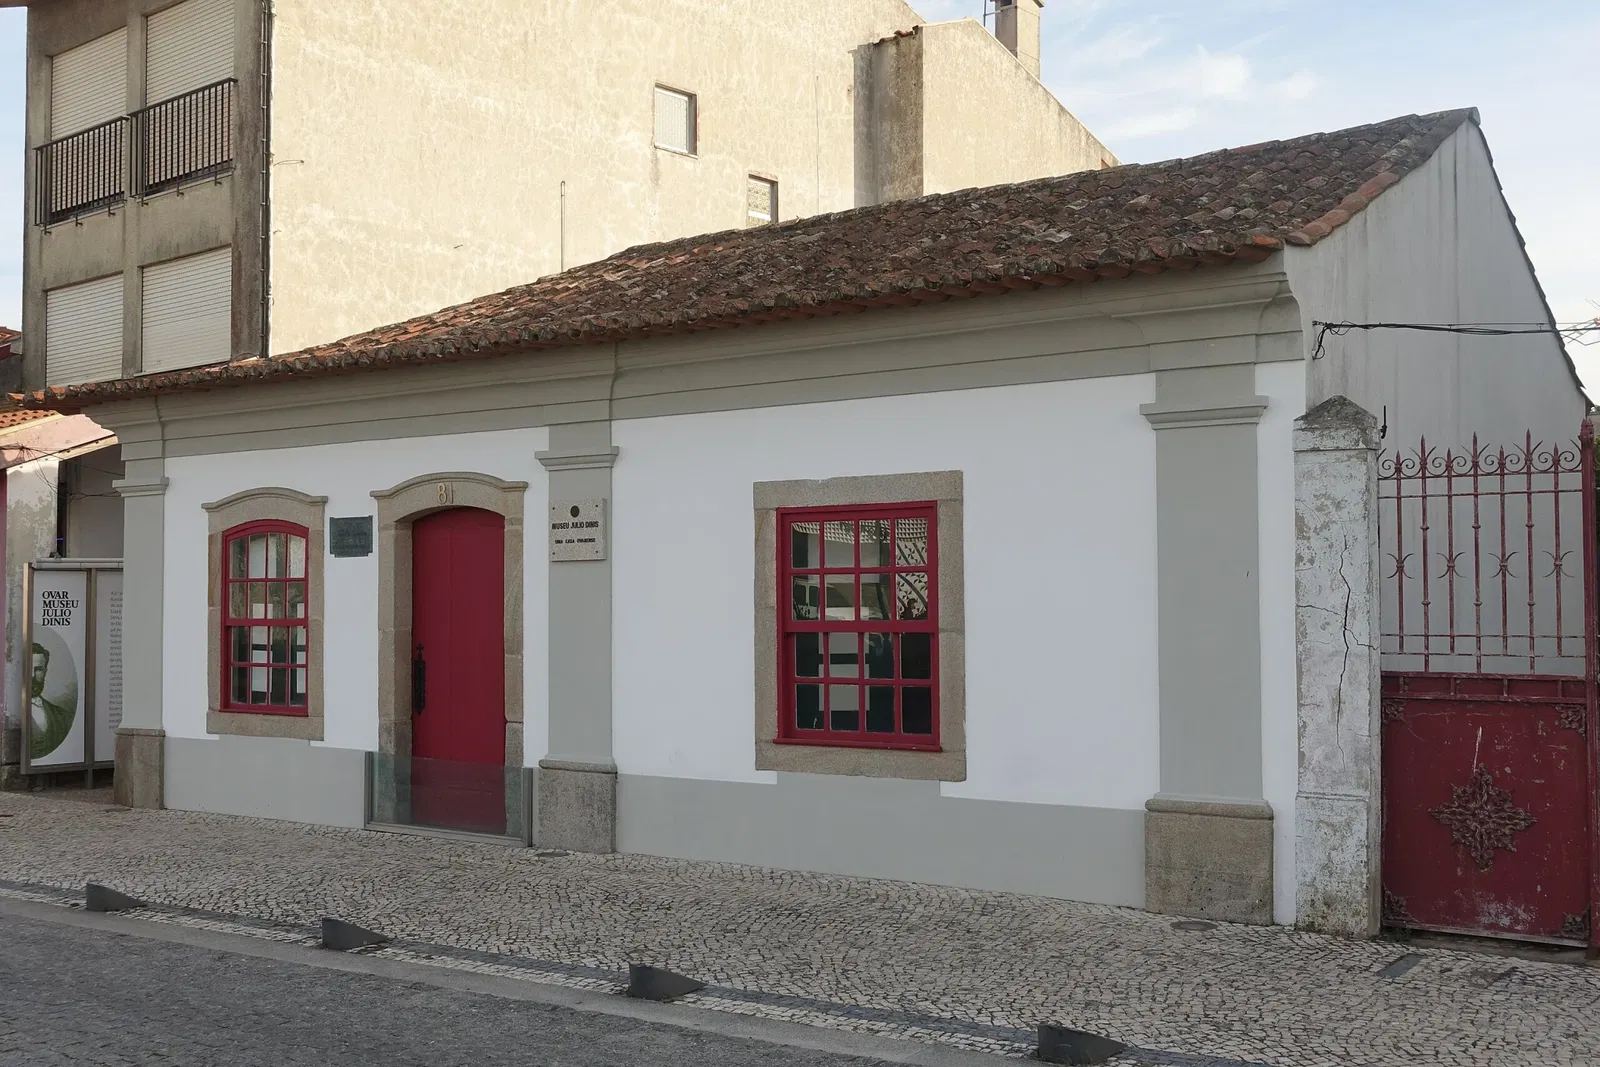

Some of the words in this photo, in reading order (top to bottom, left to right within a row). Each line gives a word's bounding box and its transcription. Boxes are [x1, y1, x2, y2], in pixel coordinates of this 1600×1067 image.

[437, 482, 453, 505] 81
[551, 522, 570, 530] MUSEU
[41, 590, 69, 600] OVAR
[42, 599, 80, 609] MUSEU
[41, 617, 71, 627] DINIS
